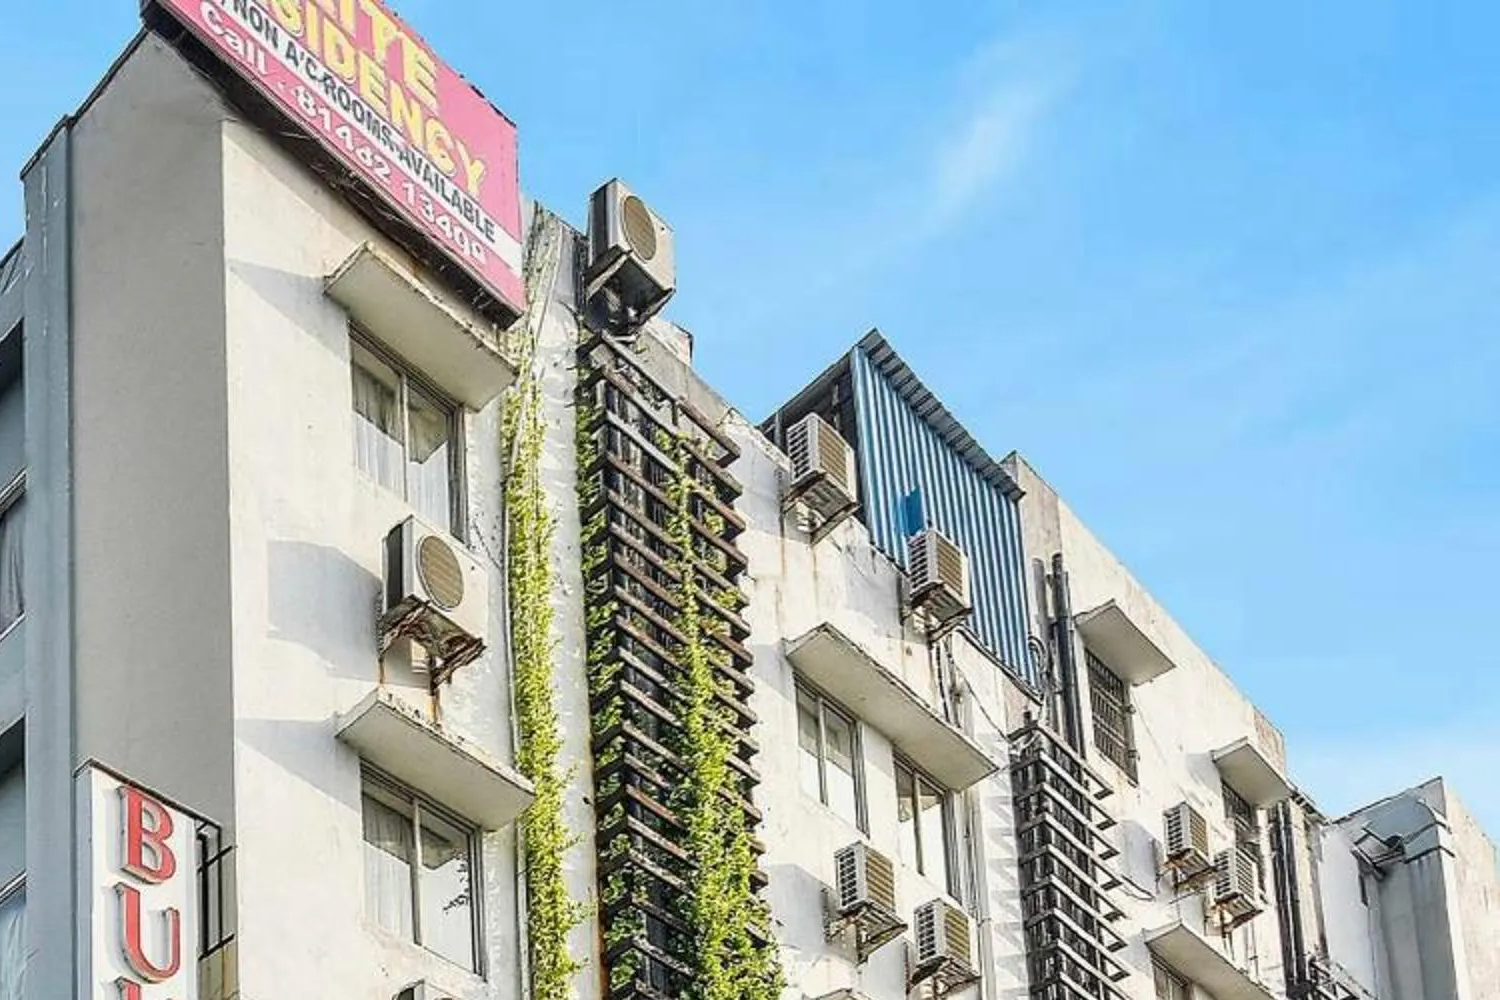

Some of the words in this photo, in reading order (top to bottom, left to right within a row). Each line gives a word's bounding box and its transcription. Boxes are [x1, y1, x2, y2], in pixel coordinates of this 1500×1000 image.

[200, 3, 269, 76] Call
[312, 0, 439, 117] ITE
[323, 73, 394, 151] ROOMS
[398, 146, 496, 245] AVAILABLE
